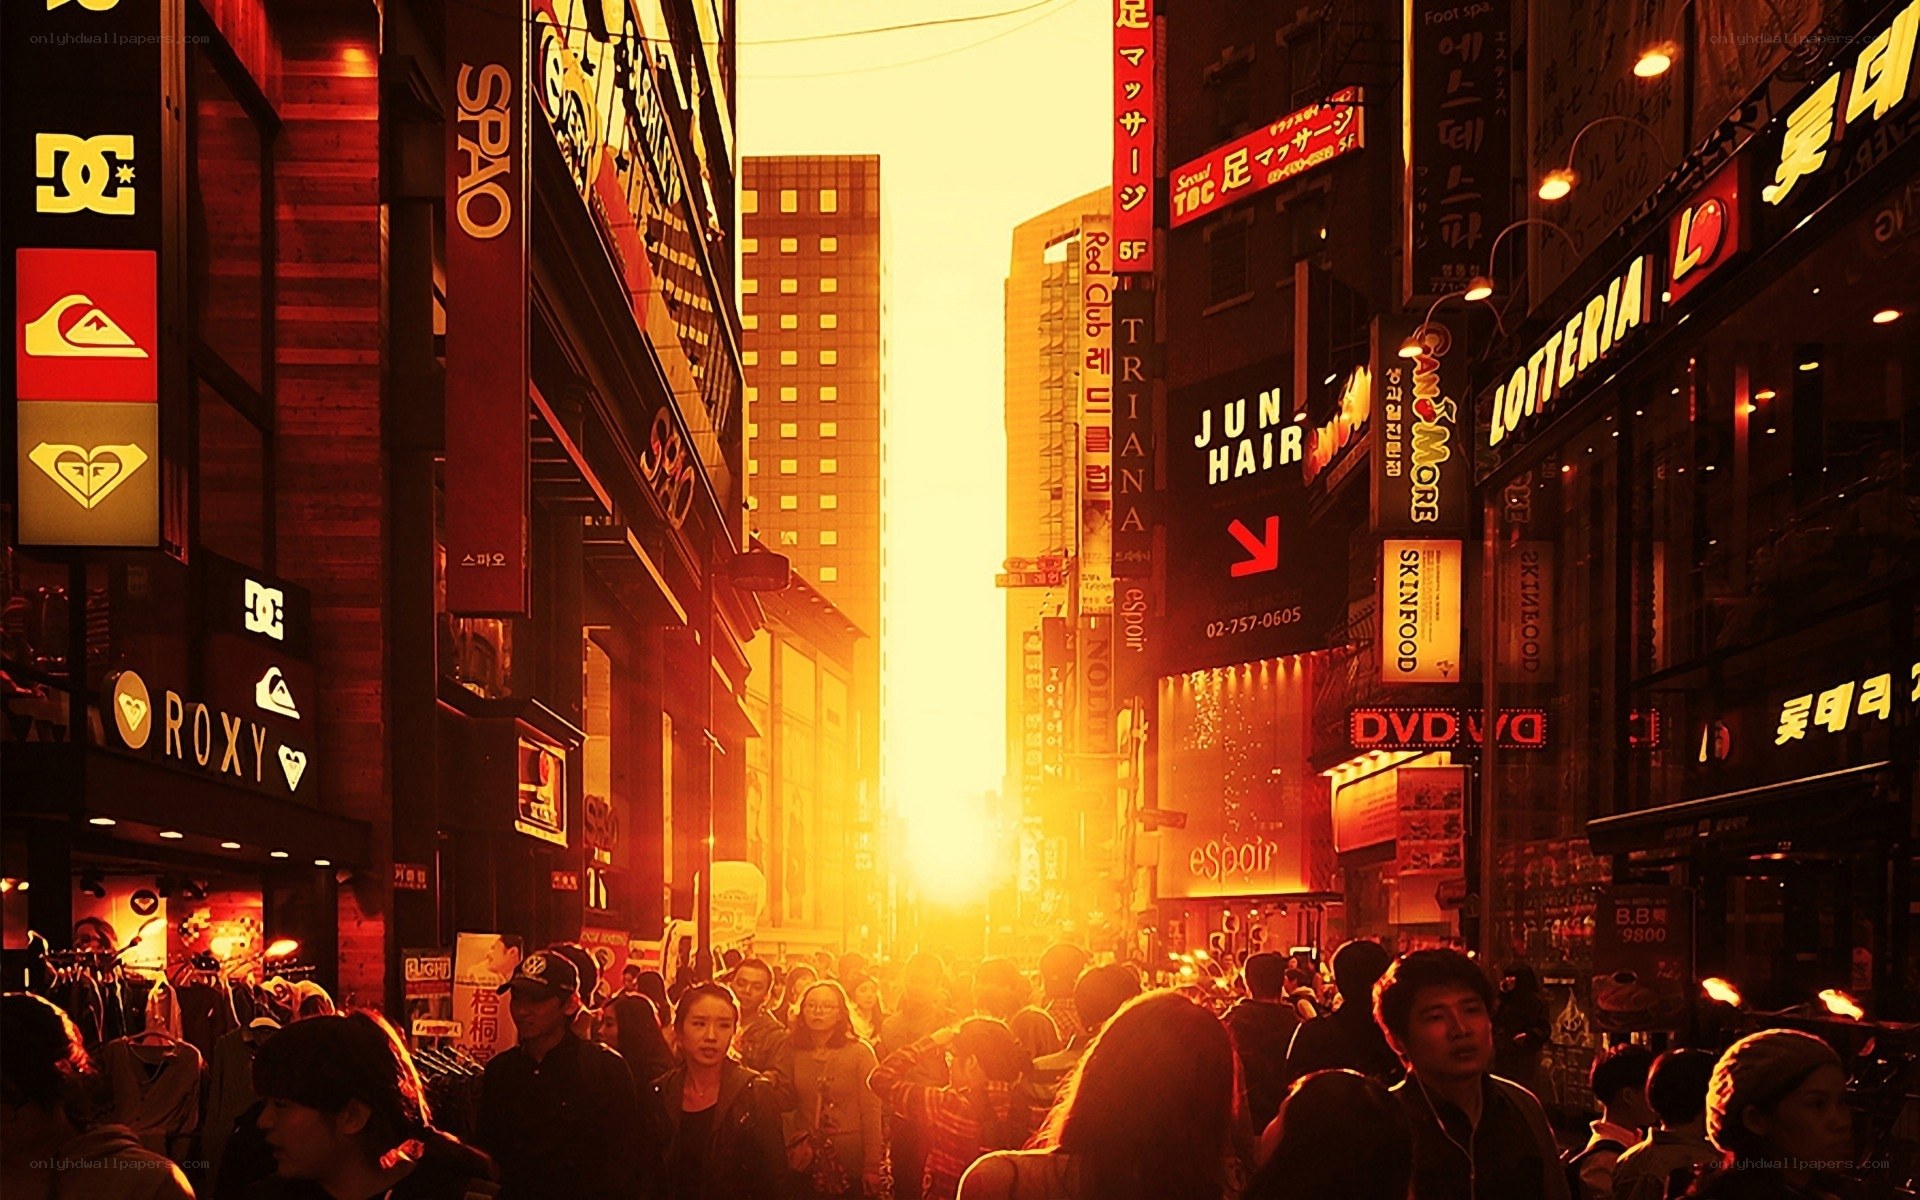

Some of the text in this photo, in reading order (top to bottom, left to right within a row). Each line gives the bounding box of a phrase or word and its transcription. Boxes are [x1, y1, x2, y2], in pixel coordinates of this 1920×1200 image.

[1424, 8, 1460, 26] Foot
[36, 133, 135, 215] DC
[457, 63, 511, 239] SPAO
[1085, 232, 1111, 338] Red Club
[1119, 242, 1146, 260] 5F
[1490, 256, 1643, 446] LOTTERIA
[1085, 347, 1111, 492] 레드클럽
[1120, 318, 1147, 532] TRIANA
[1195, 388, 1280, 448] JUN
[1209, 425, 1302, 484] HAIR
[1410, 421, 1450, 523] MORE
[461, 553, 506, 567] 스파오
[245, 579, 283, 640] DC
[1120, 589, 1147, 652] espoir
[1207, 606, 1301, 638] 02-757-0605
[1397, 549, 1419, 672] SKINFOOD
[166, 691, 266, 782] ROXY
[1356, 713, 1456, 743] DVD
[1775, 662, 1920, 745] 롯데리
[1189, 835, 1278, 882] espoir
